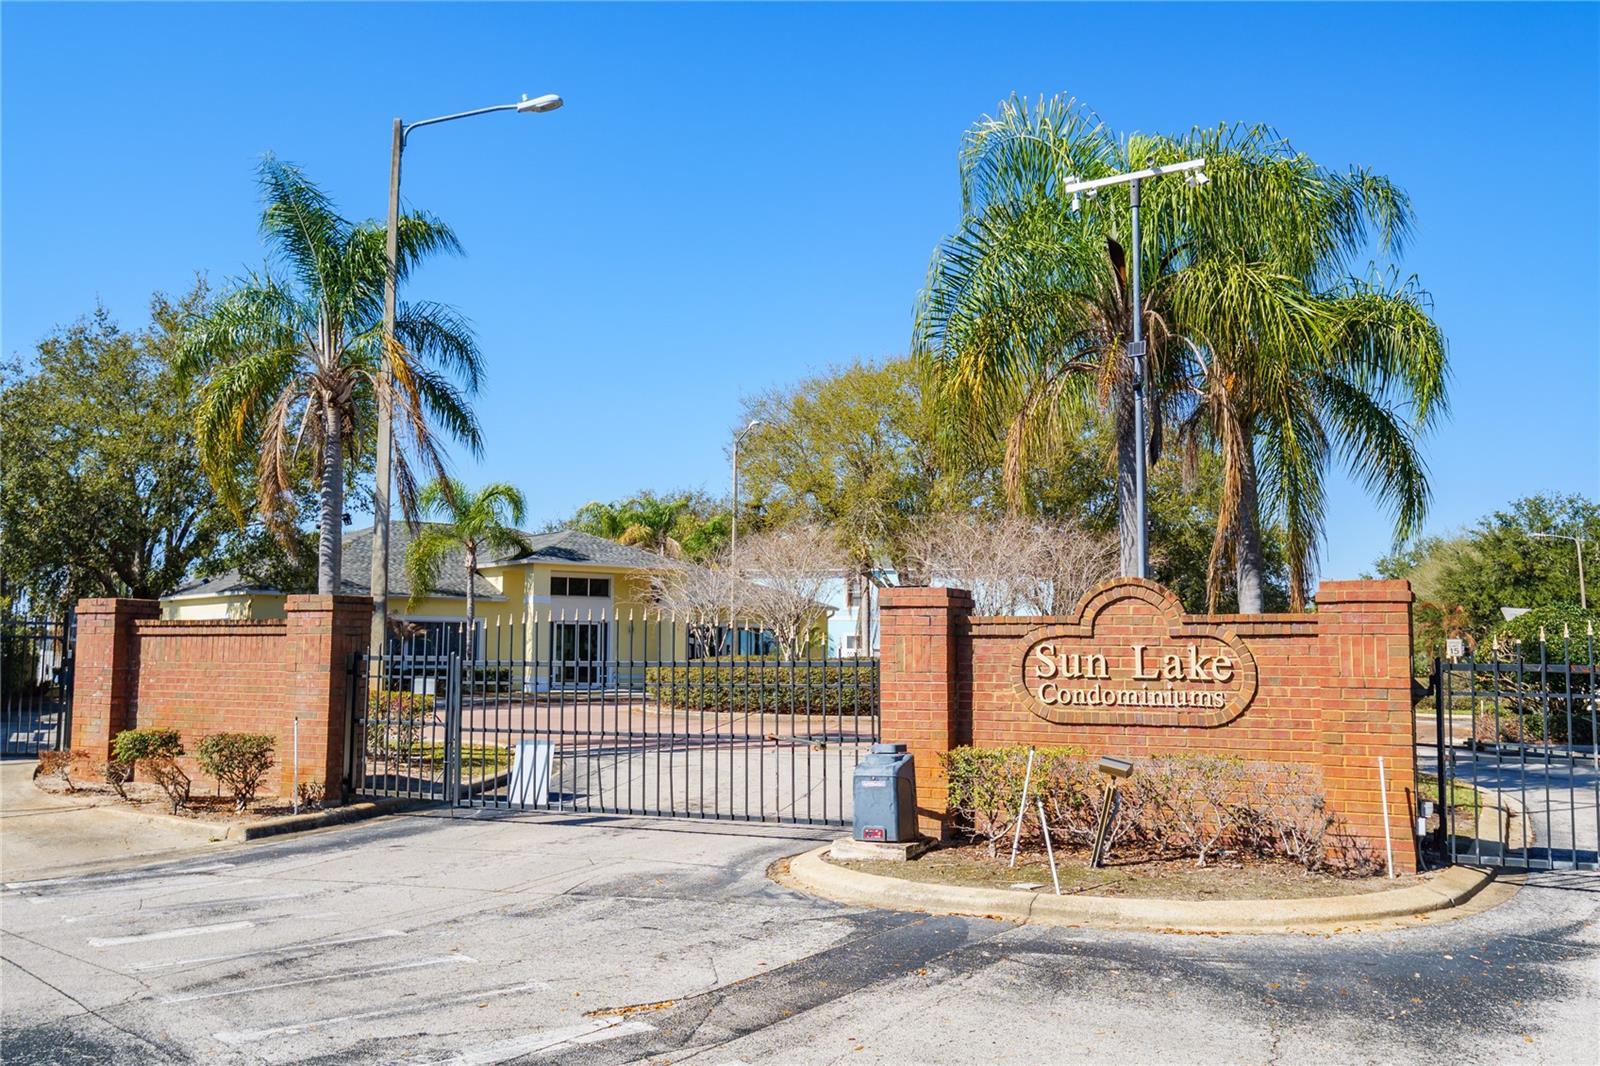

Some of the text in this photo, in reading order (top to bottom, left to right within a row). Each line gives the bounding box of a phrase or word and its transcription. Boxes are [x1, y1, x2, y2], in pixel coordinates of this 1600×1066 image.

[1035, 643, 1233, 681] Sun Lake
[1038, 682, 1225, 708] Condominiums
